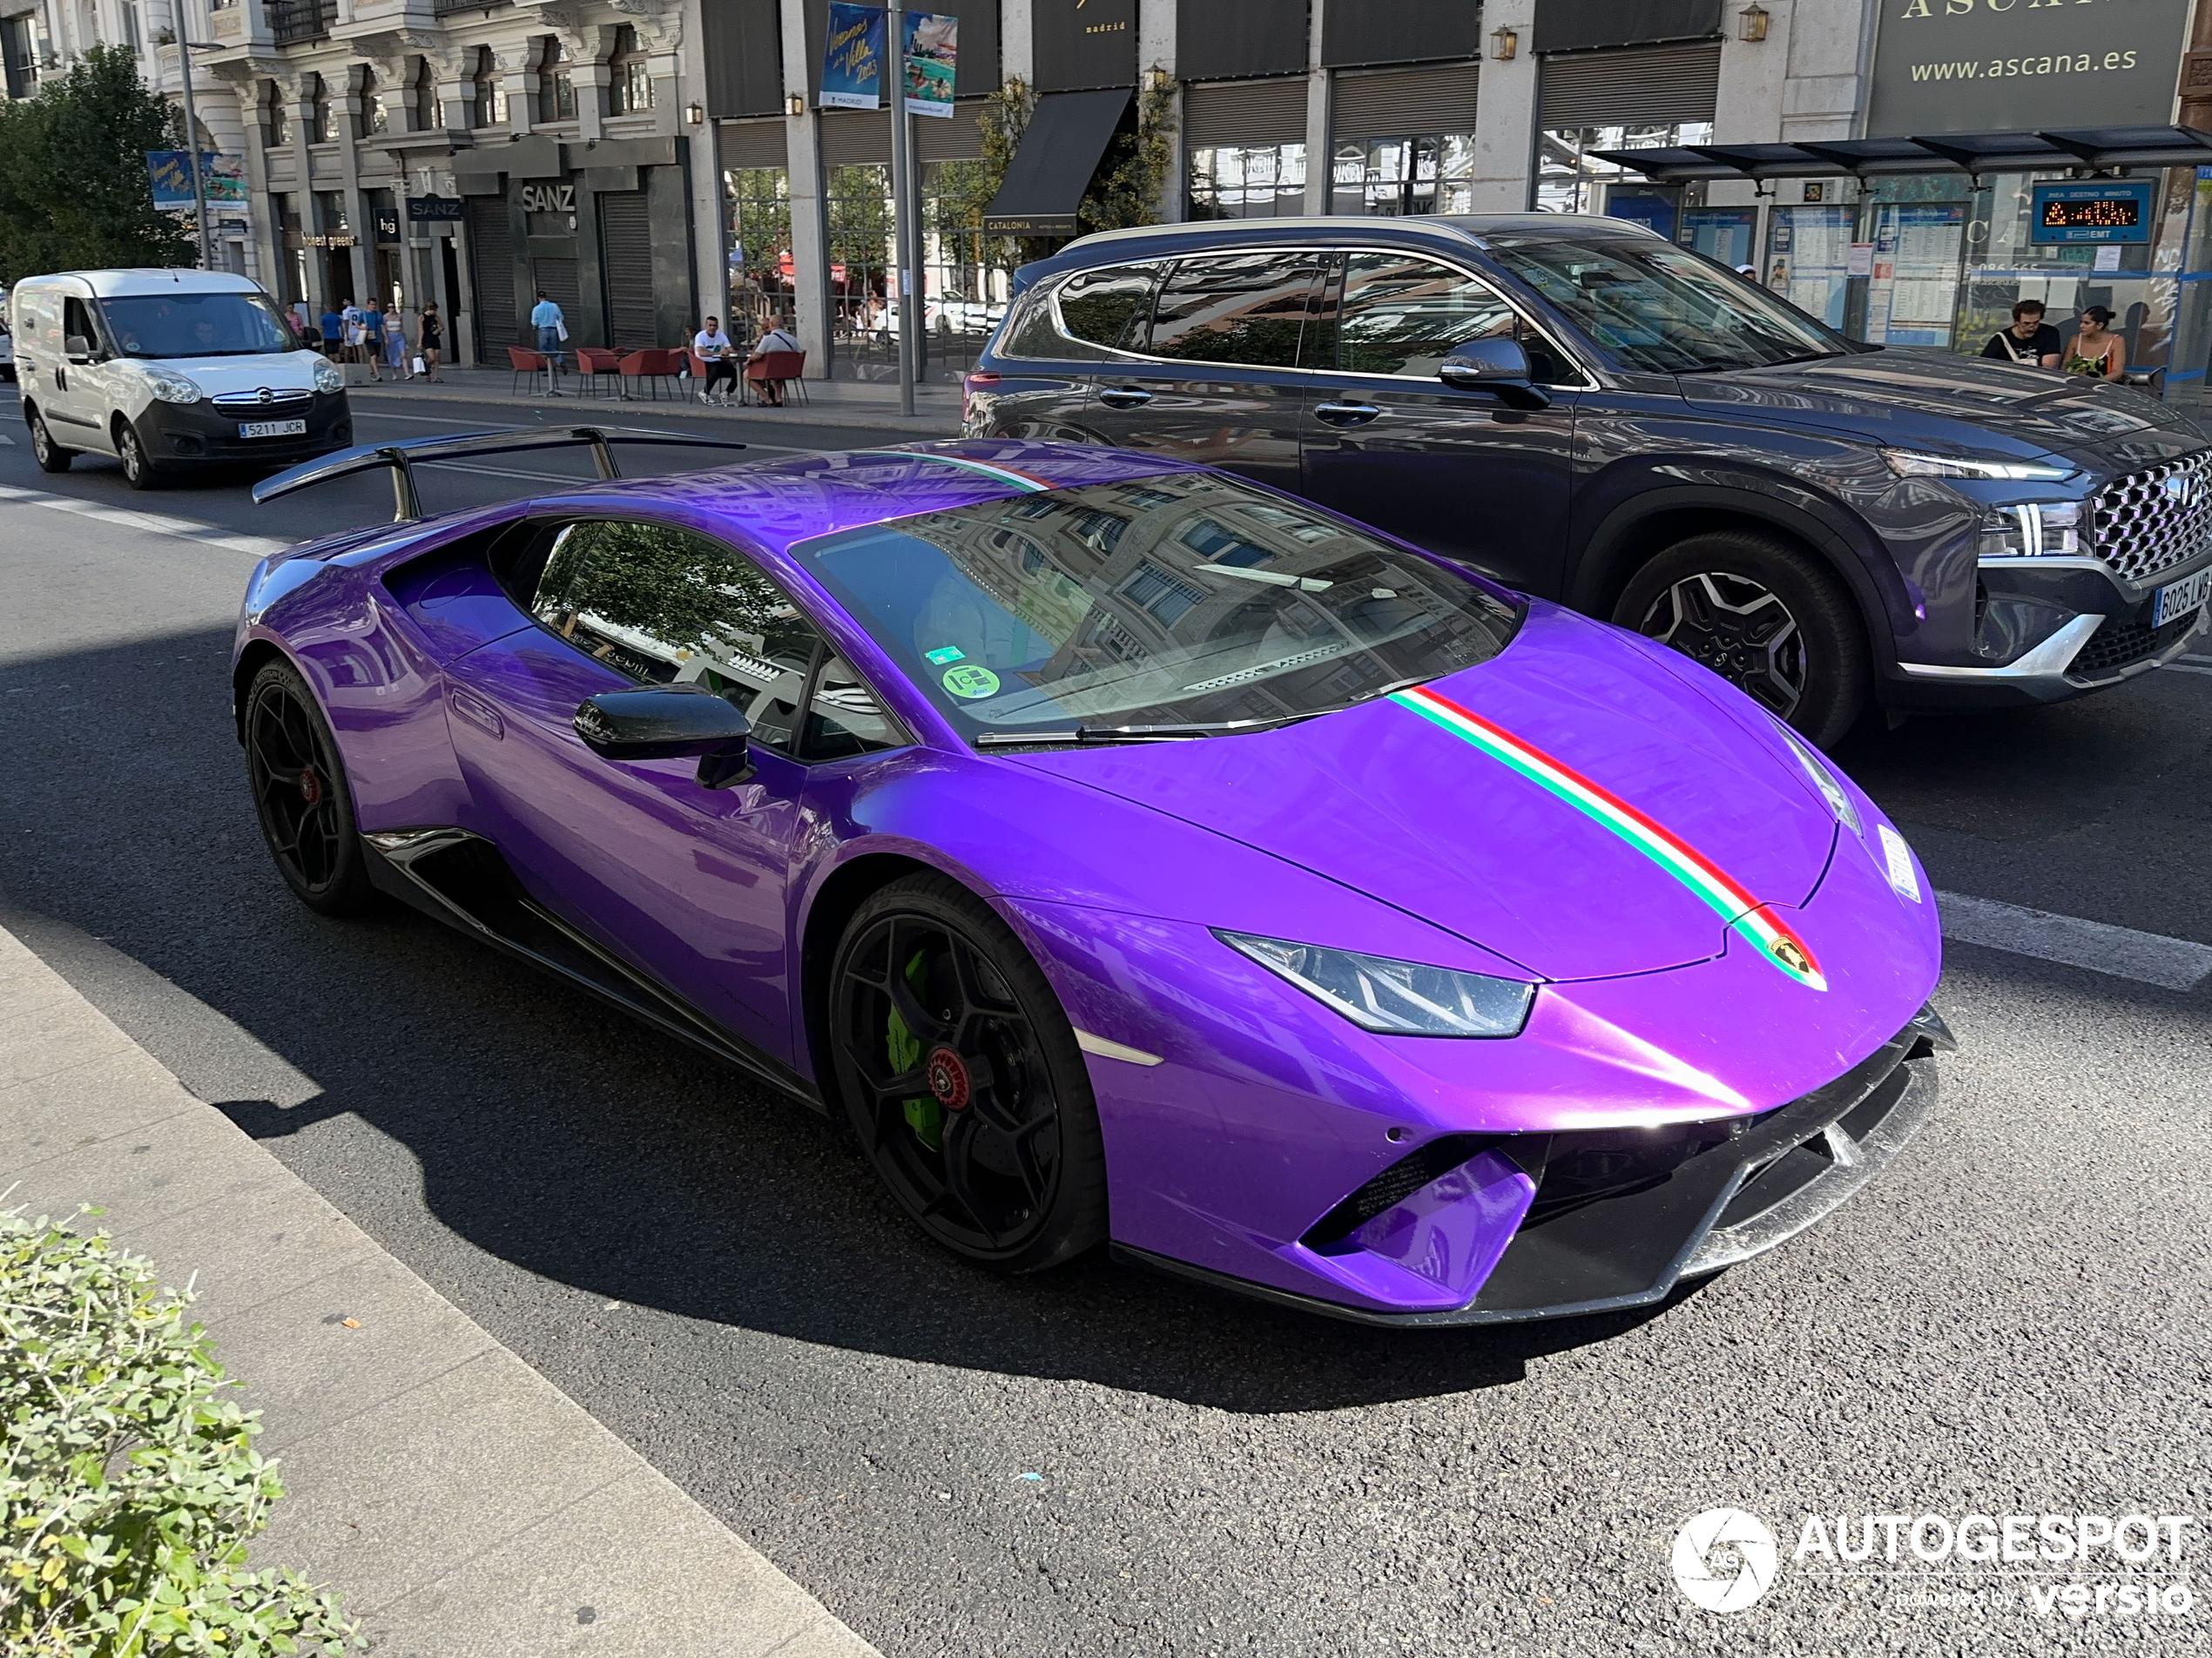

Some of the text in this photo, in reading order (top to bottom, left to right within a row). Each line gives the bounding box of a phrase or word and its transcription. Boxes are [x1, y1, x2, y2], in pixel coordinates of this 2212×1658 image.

[1086, 22, 1125, 33] madrid
[846, 38, 873, 77] Villa
[856, 59, 877, 84] 2023
[1912, 50, 2137, 81] www.ascana.es
[523, 185, 575, 212] SANZ
[412, 204, 460, 216] SANZ
[381, 219, 395, 233] hg
[988, 221, 1030, 230] CATALONIA
[2090, 230, 2111, 239] EMT
[248, 422, 303, 435] 5211 JCR
[2161, 582, 2190, 620] 6025
